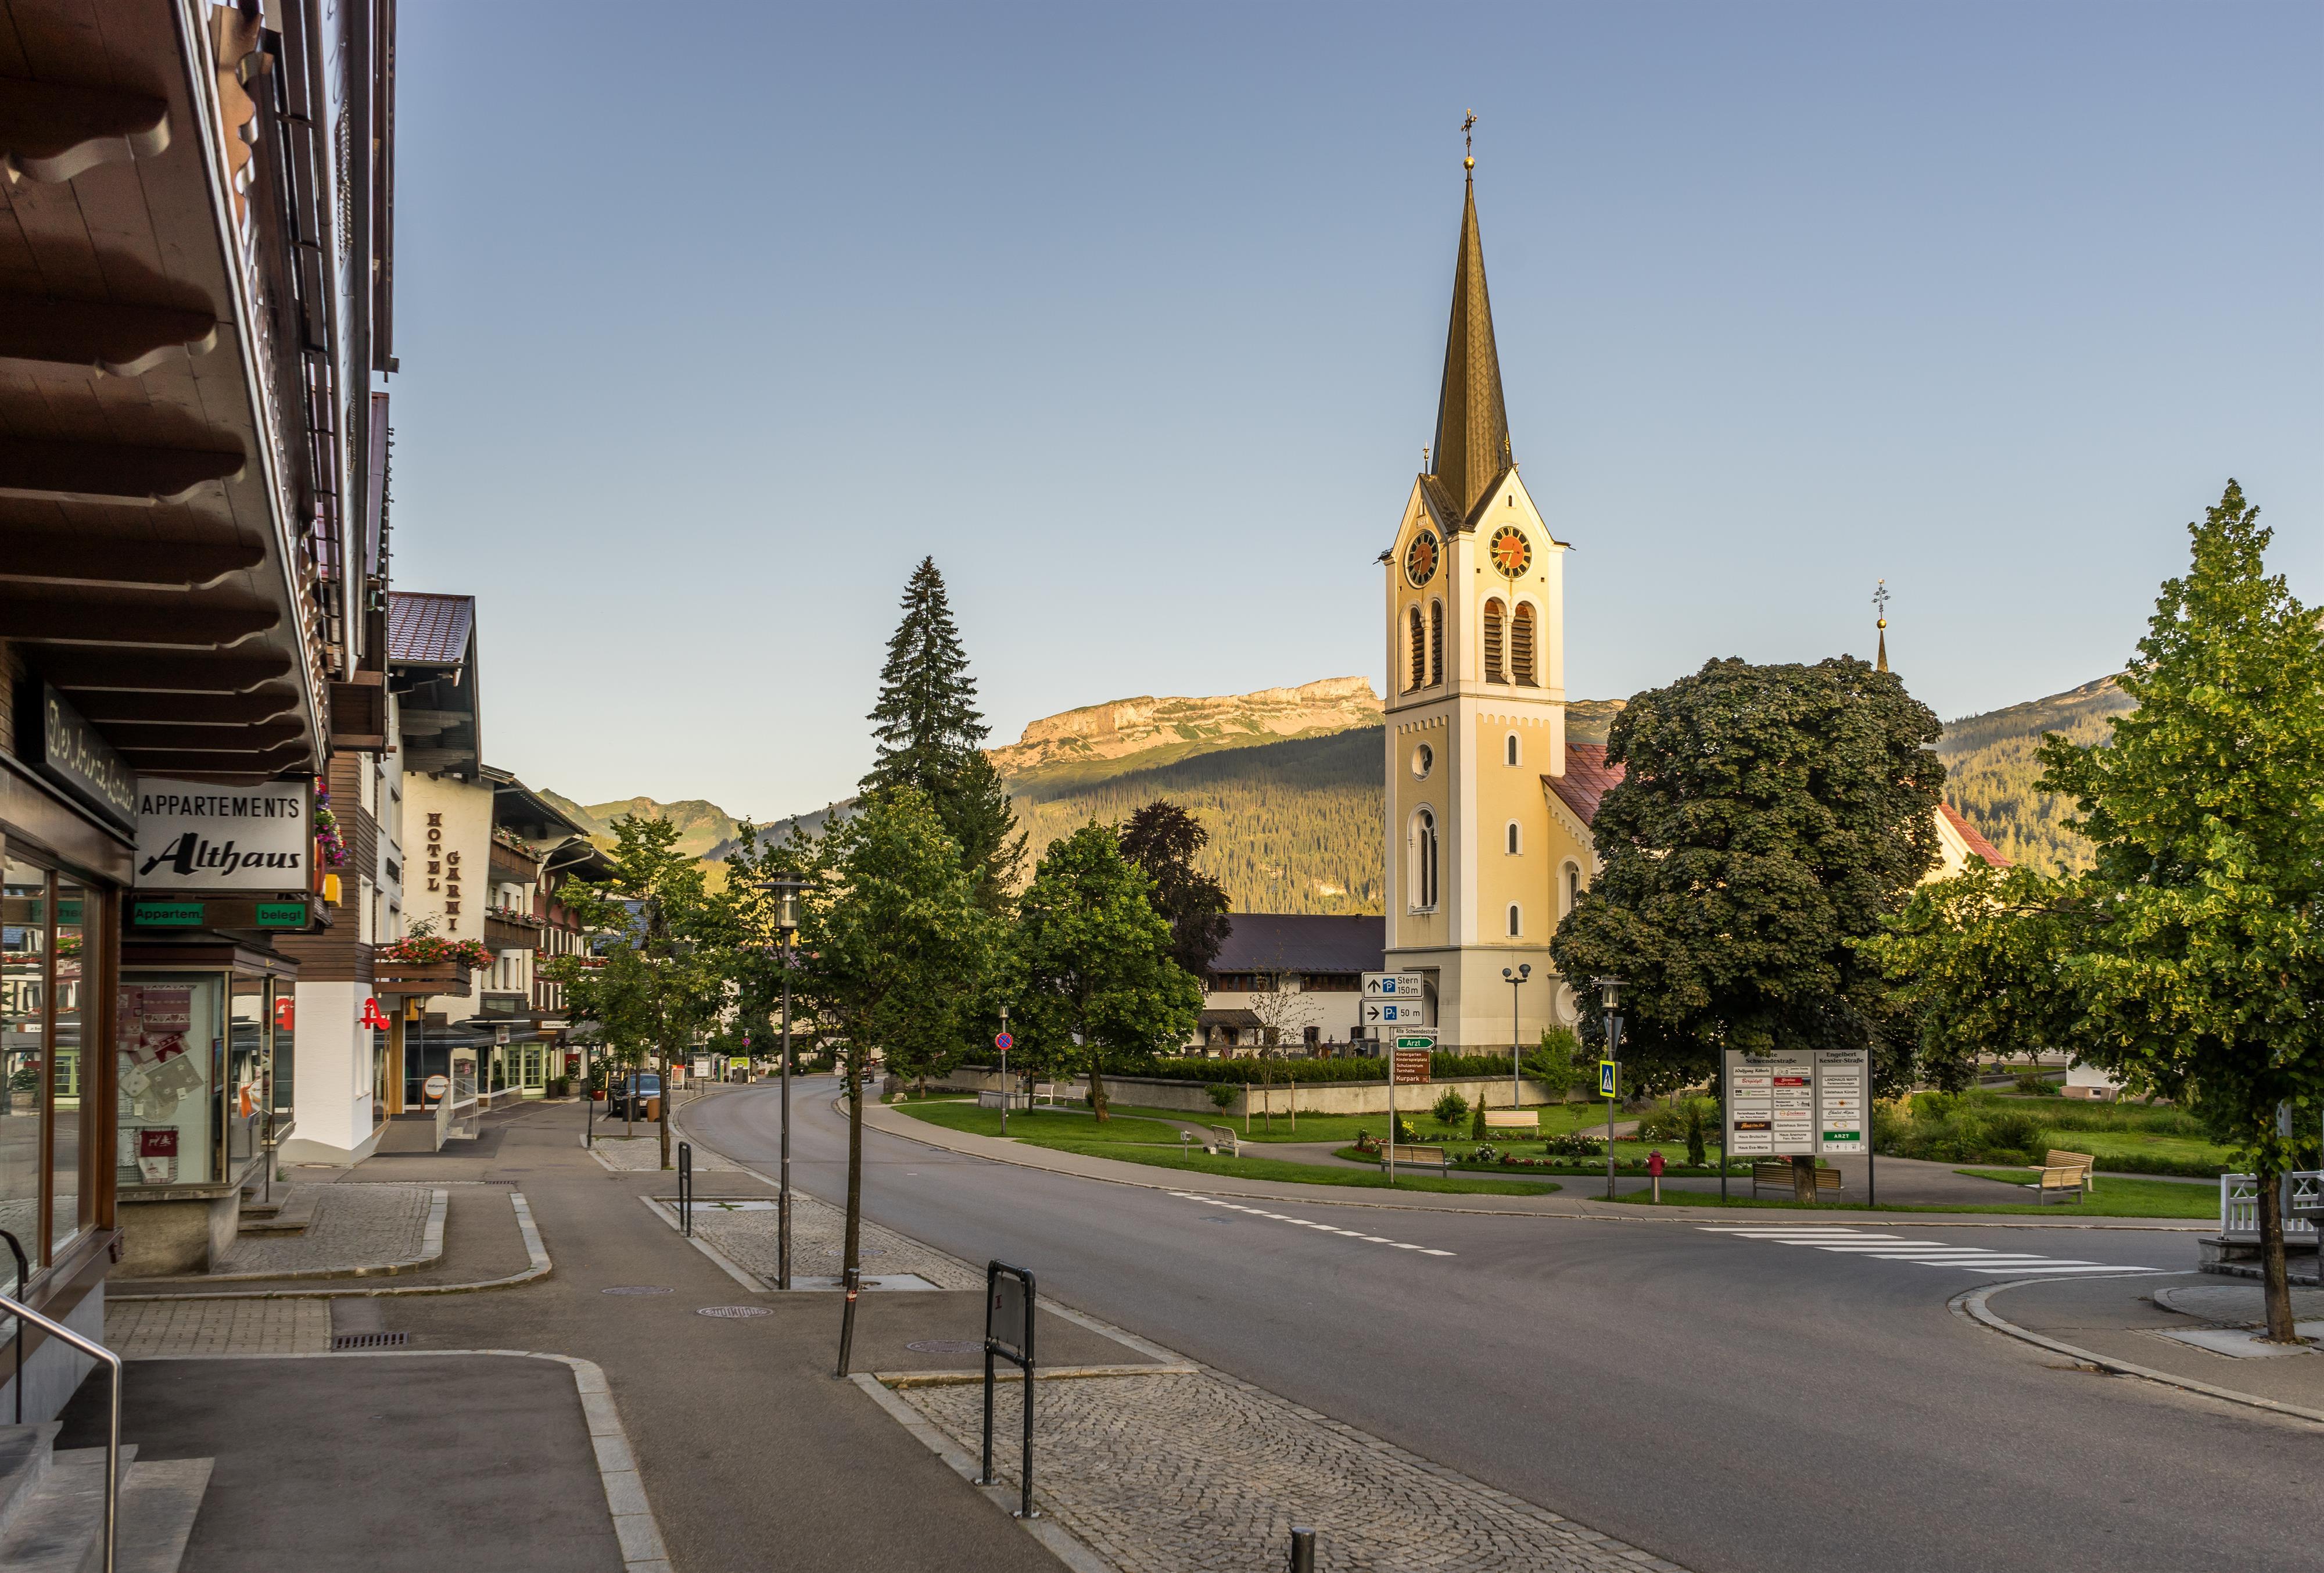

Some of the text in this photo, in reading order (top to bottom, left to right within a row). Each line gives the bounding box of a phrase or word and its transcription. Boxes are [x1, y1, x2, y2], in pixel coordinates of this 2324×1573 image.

[141, 794, 299, 818] APPARTEMENTS
[139, 832, 302, 876] Althaus
[426, 812, 442, 891] HOTEL
[445, 850, 462, 931] GARNI
[261, 910, 302, 922] belegt
[1397, 976, 1418, 984] Stern
[1400, 1009, 1410, 1017] 50
